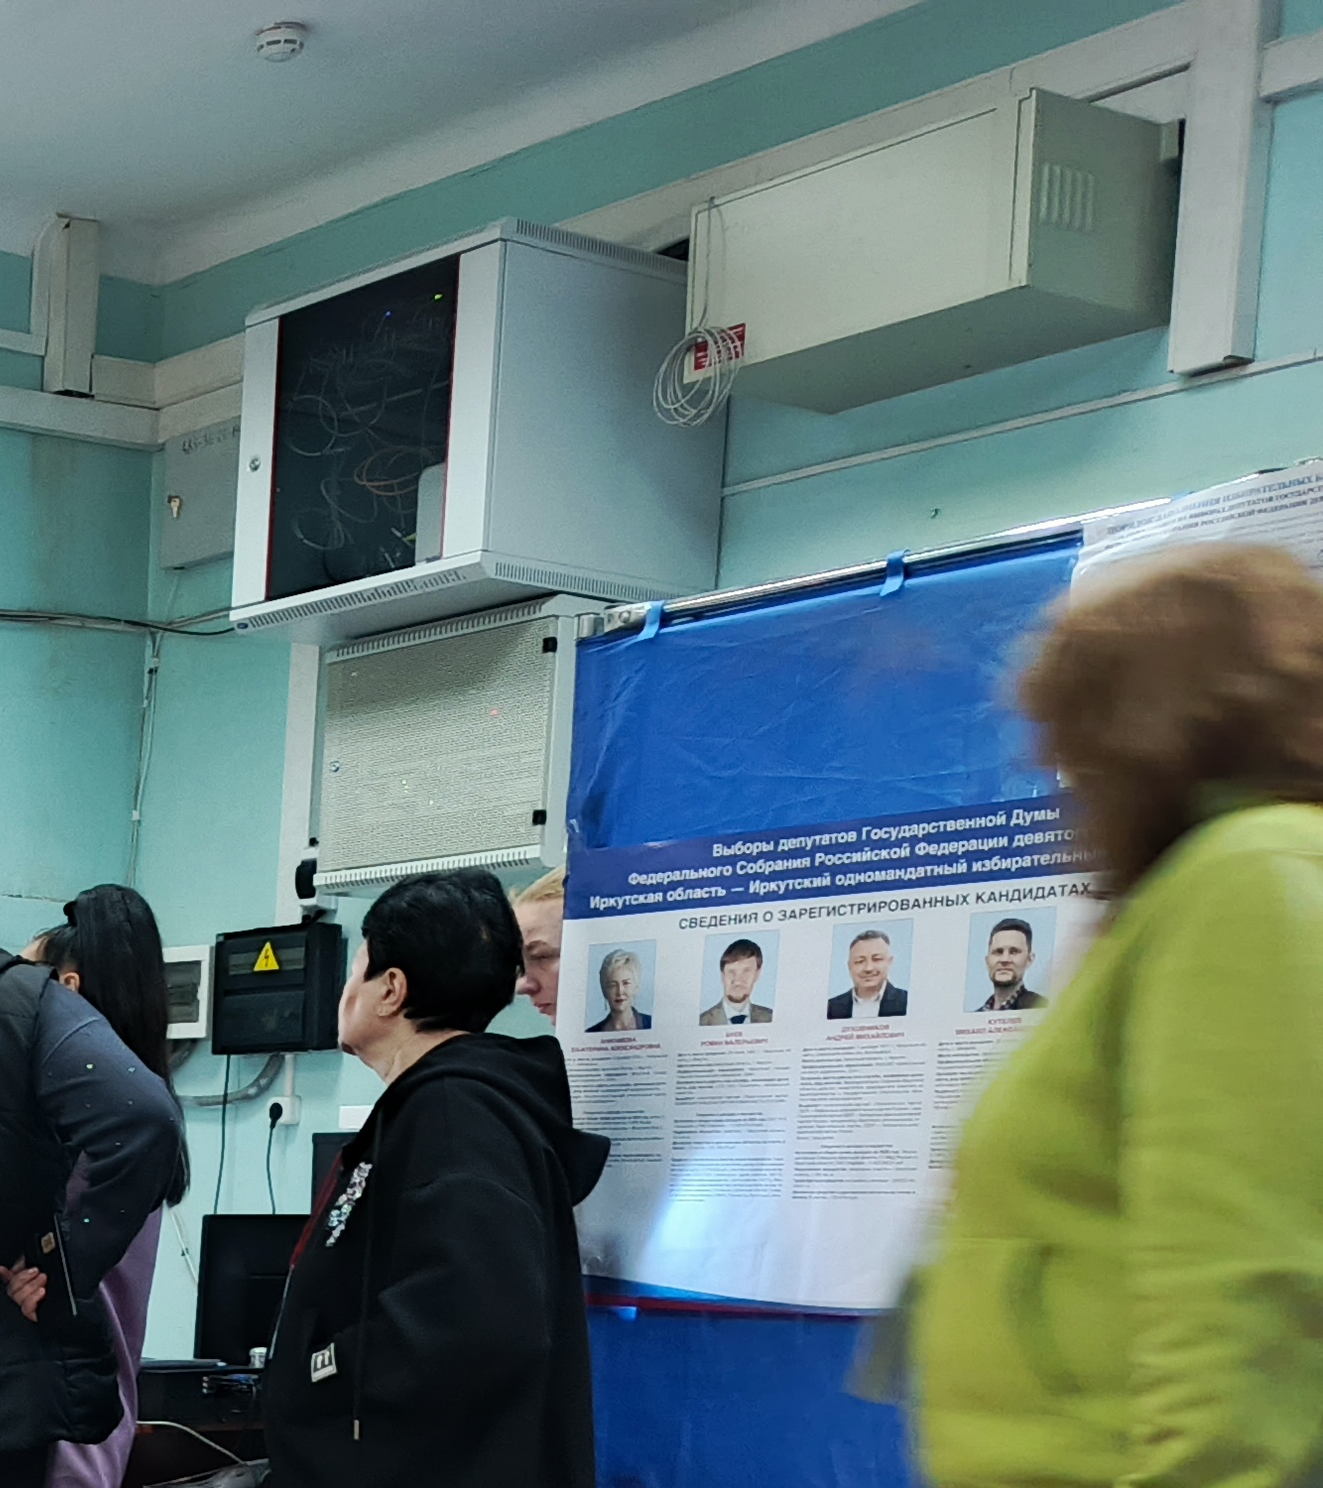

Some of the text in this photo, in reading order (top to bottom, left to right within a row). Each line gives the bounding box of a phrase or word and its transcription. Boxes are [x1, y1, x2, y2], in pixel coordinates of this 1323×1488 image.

[628, 828, 1077, 887] Федерального Собрания Российской Федерации девято
[712, 808, 1060, 857] Выборы депутатов Государственной Думы
[590, 890, 663, 911] Иркутская
[667, 885, 726, 902] область
[749, 872, 831, 895] Иркутский
[835, 860, 968, 887] одномандатный
[678, 881, 1091, 930] СВЕДЕНИЯ О ЗАРЕГИСТРИРОВАННЫХ КАНДИДАТАХ
